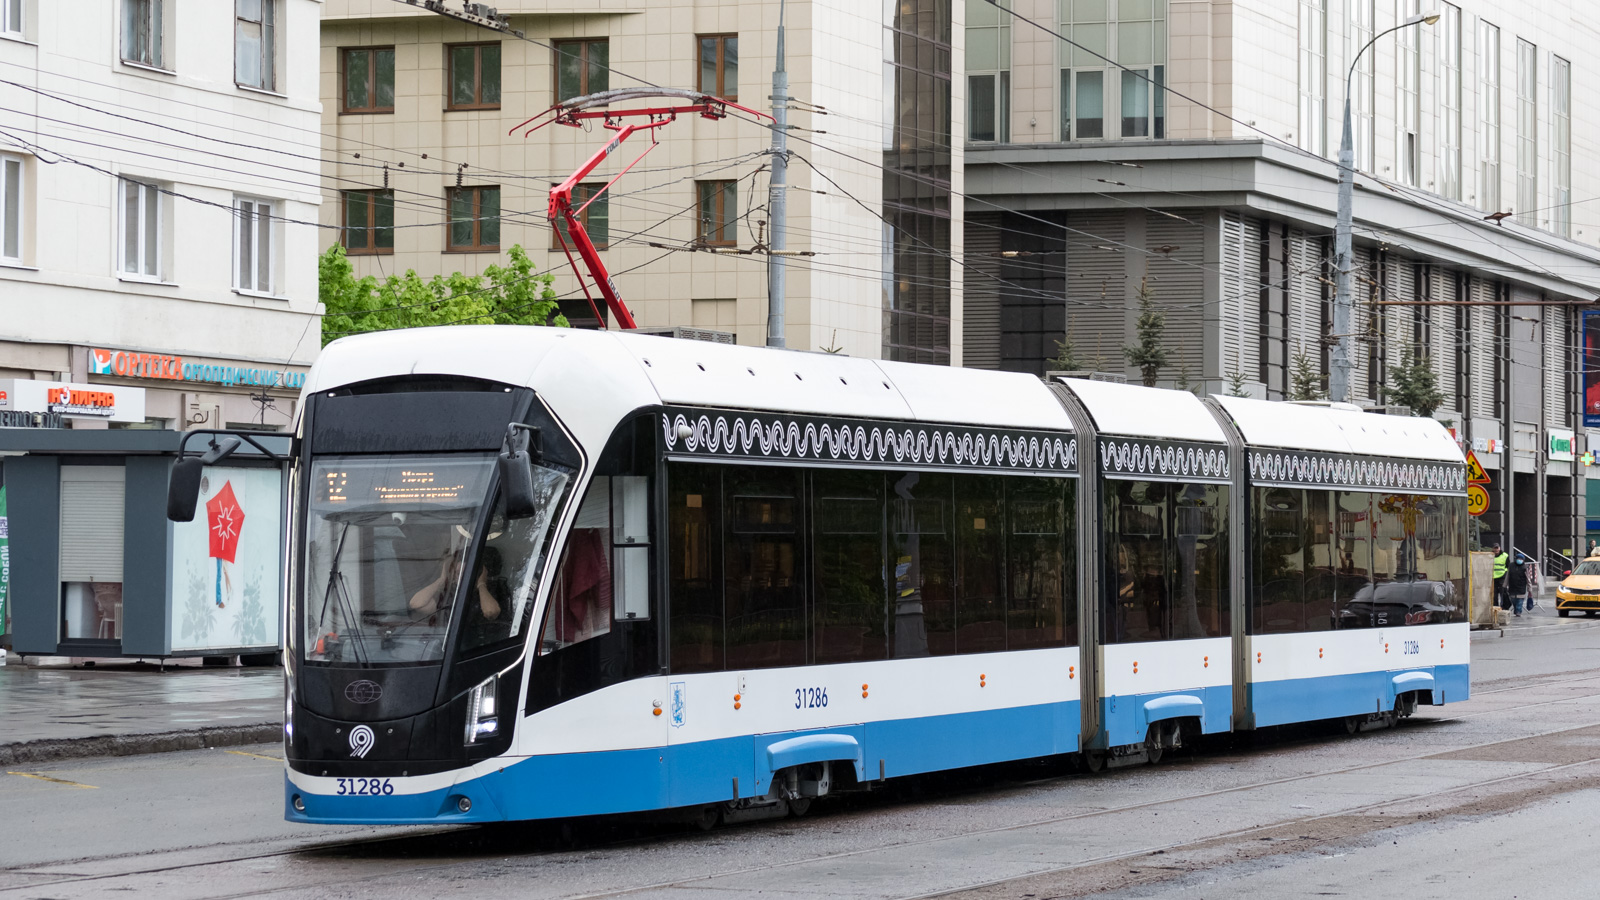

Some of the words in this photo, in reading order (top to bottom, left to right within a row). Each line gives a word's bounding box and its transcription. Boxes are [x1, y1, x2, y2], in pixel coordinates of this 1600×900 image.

[112, 351, 184, 380] ОРТЕКА
[184, 363, 279, 387] ОРТОПЕДИЧЕСКИЕ
[48, 386, 115, 407] КОПИРКА
[1468, 494, 1483, 507] 50
[1404, 640, 1420, 655] 31286
[795, 687, 828, 709] 31286
[336, 778, 394, 795] 31286
